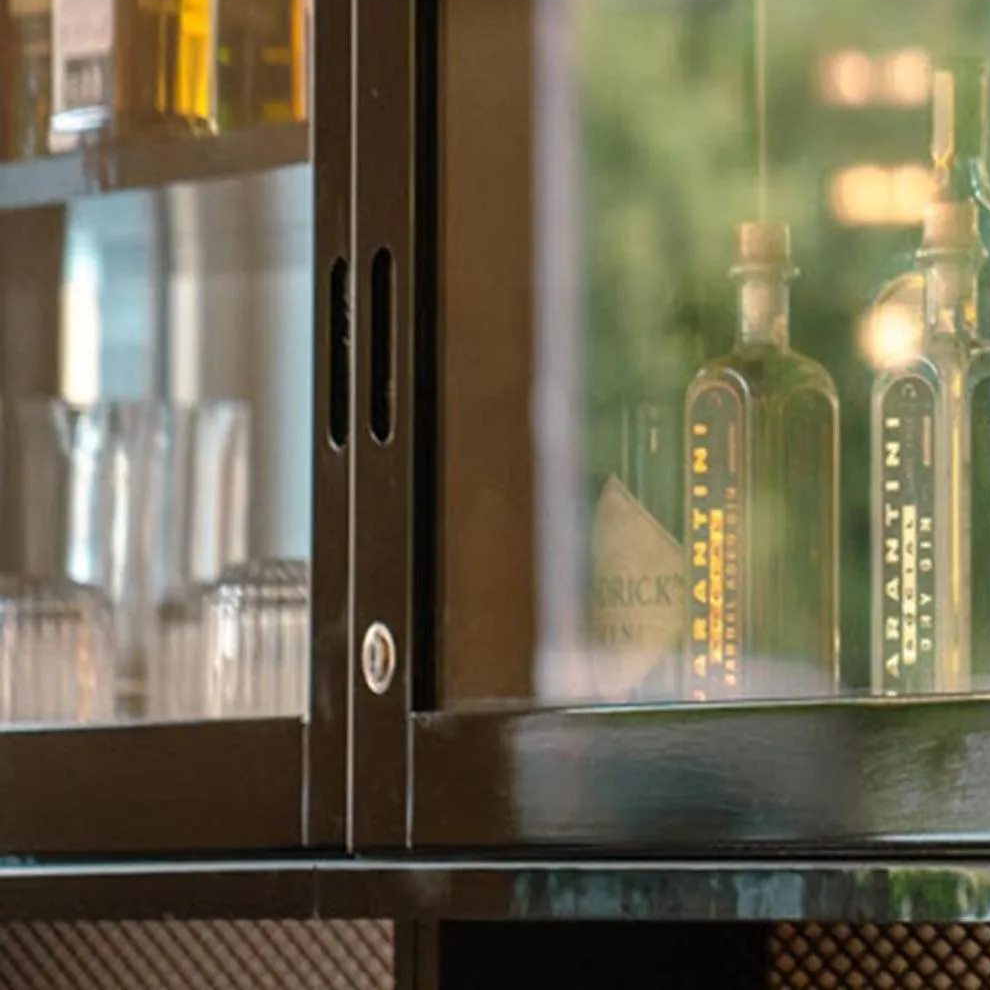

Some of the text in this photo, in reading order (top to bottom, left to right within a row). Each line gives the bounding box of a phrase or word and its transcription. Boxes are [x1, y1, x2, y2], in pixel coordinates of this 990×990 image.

[884, 417, 900, 696] ARANTINI
[919, 517, 932, 652] DRY GIN
